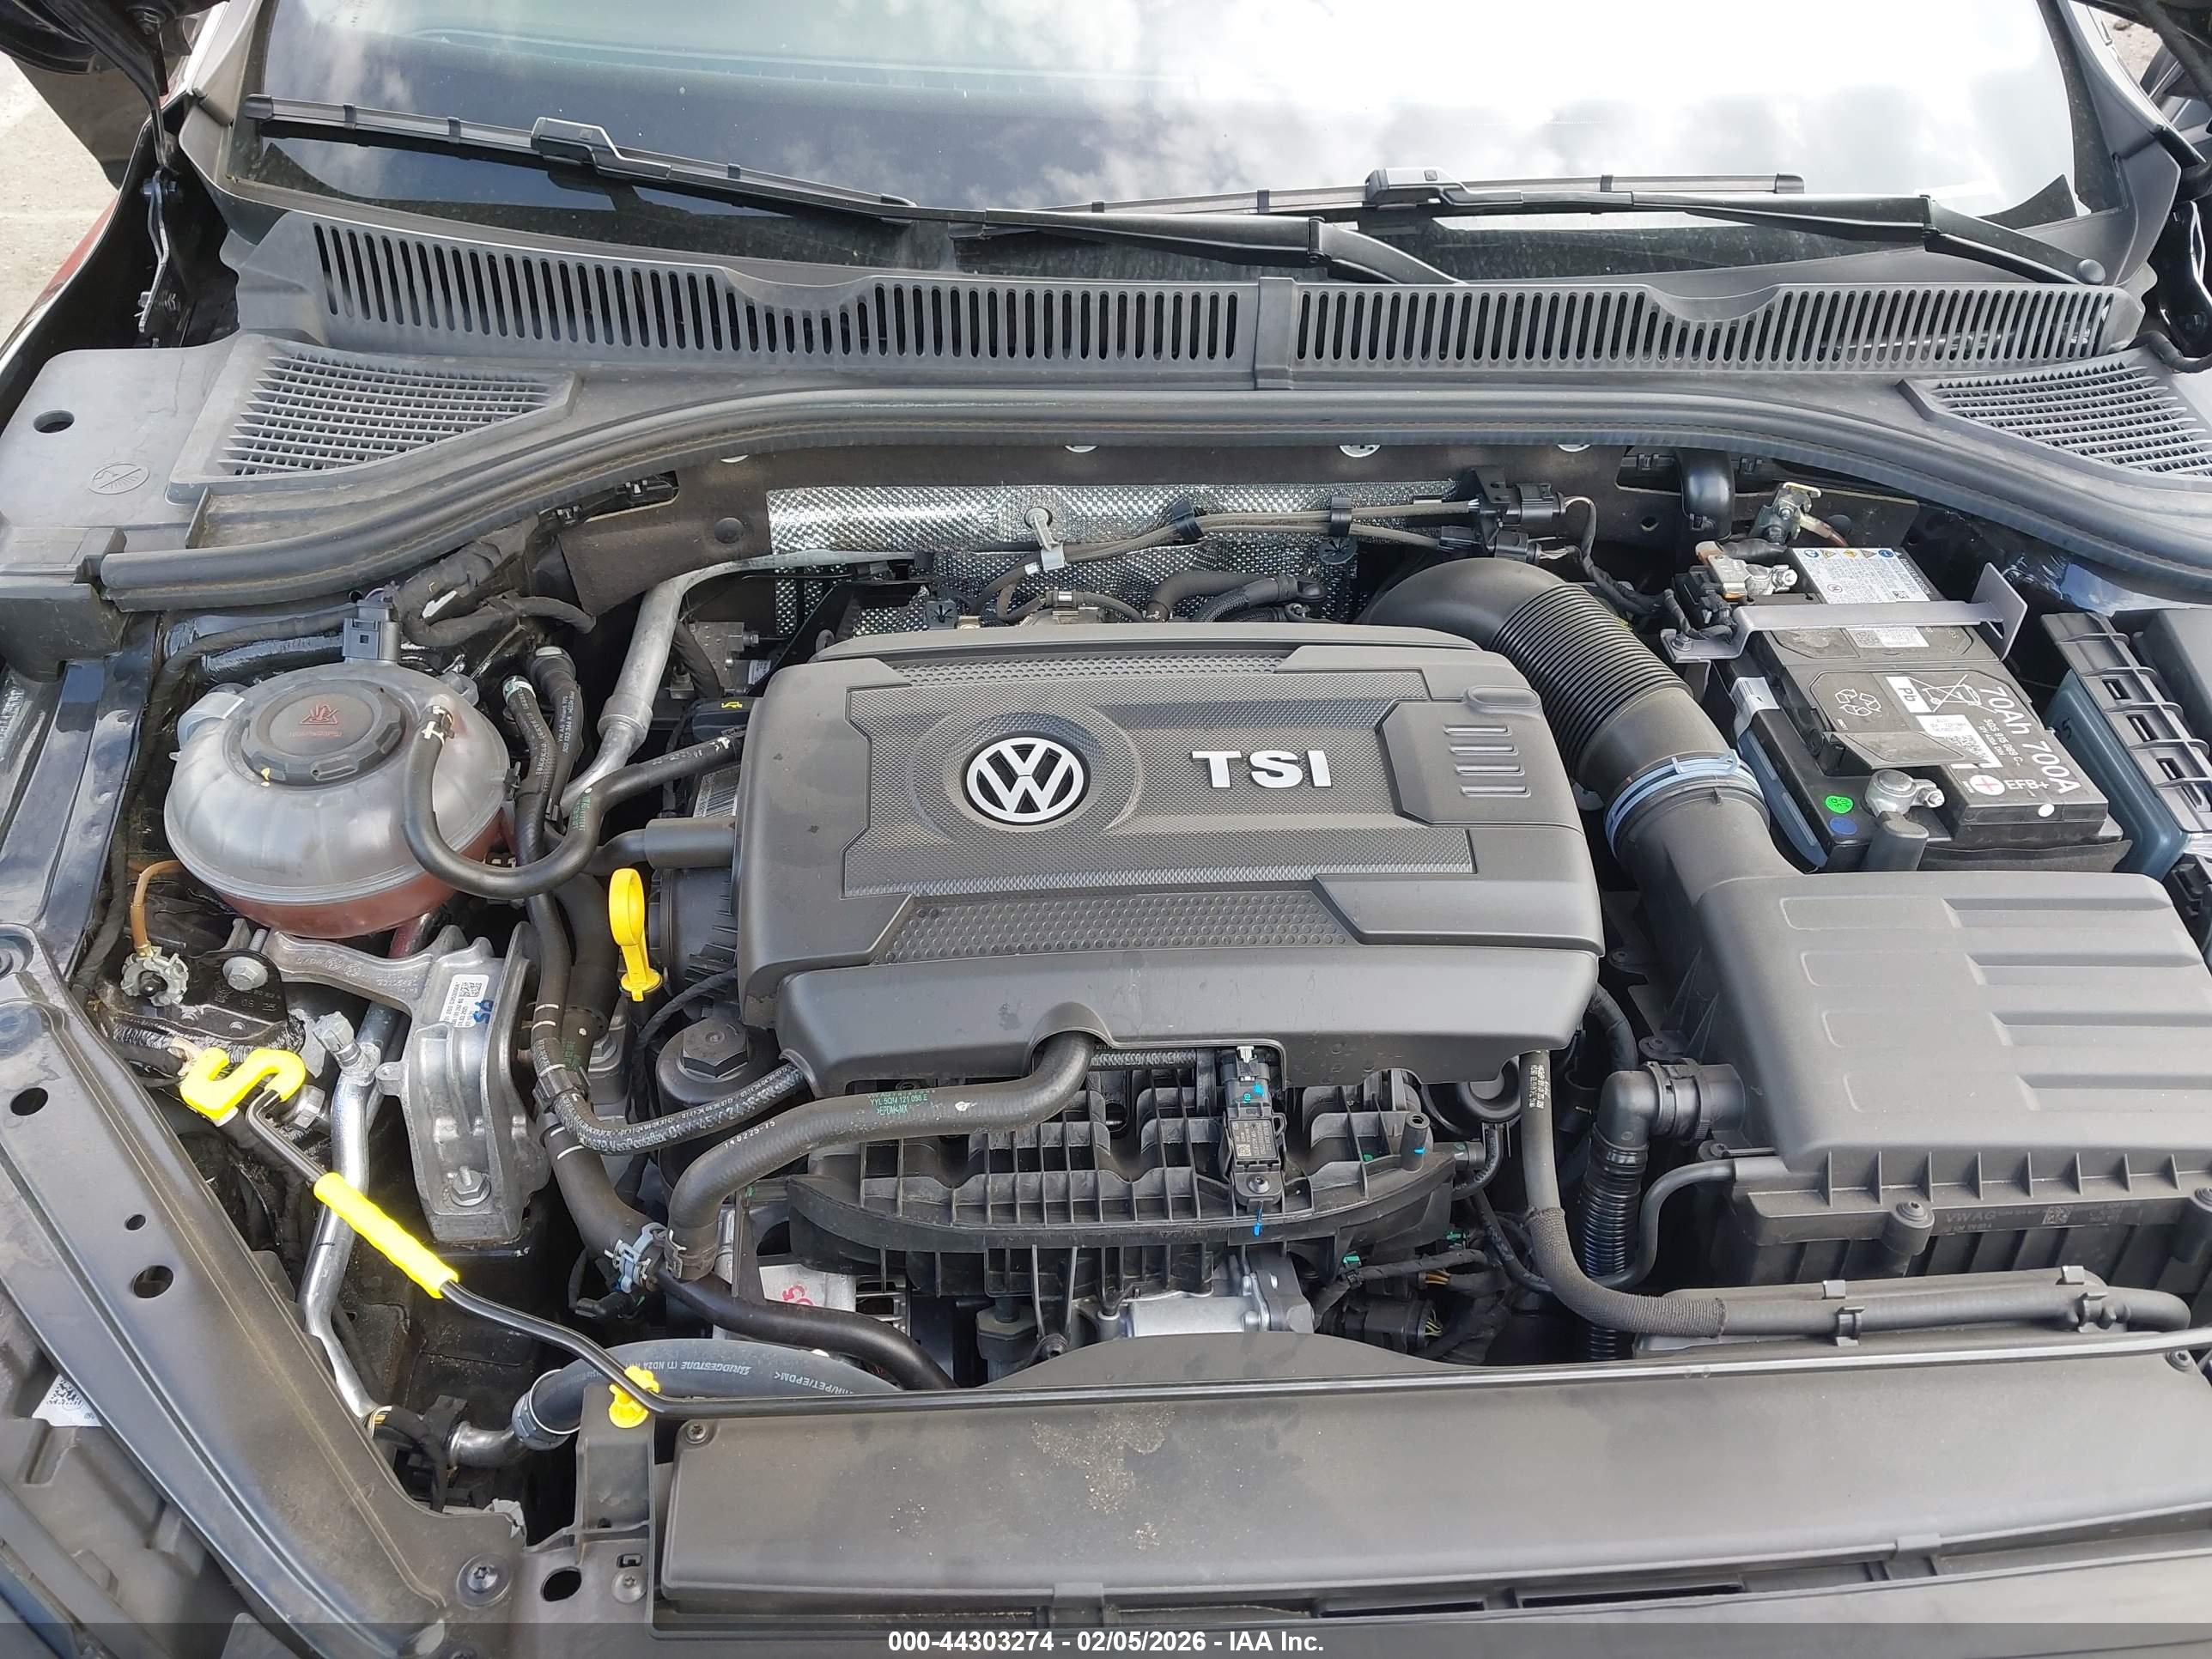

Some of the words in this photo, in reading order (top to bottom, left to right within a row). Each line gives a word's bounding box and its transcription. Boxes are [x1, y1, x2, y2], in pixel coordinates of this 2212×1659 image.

[1899, 685, 1917, 702] Pb
[1979, 685, 2034, 736] 70Ah
[2022, 740, 2081, 795] 700A
[1192, 749, 1333, 790] TSI
[681, 1361, 751, 1375] BRIDGESTONE
